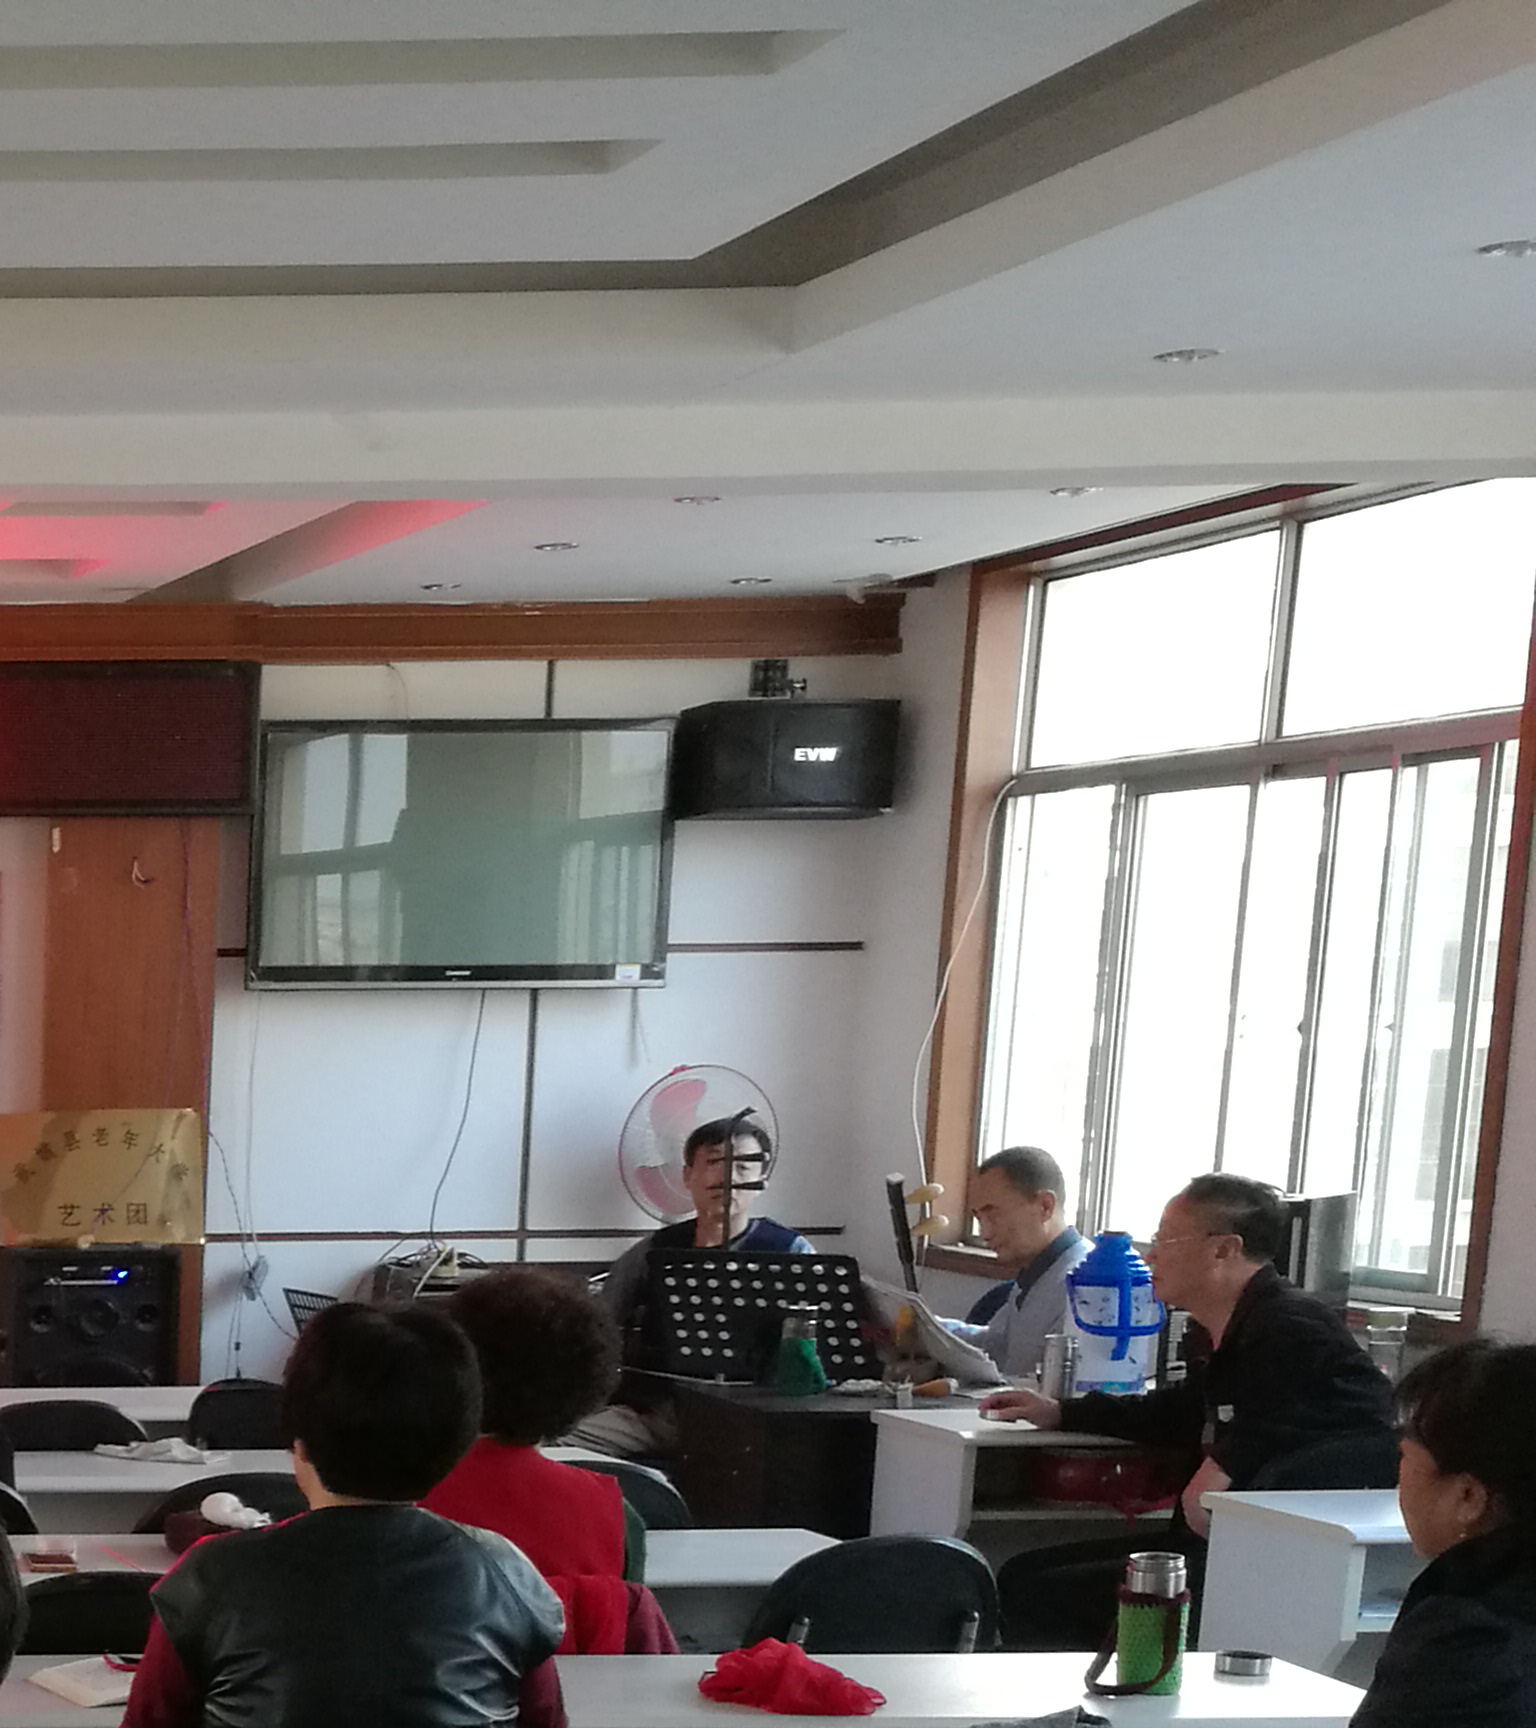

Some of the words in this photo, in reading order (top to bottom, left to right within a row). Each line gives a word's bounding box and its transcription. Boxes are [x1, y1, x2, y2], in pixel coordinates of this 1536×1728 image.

[793, 747, 838, 762] EVW
[57, 1202, 148, 1227] 艺术团
